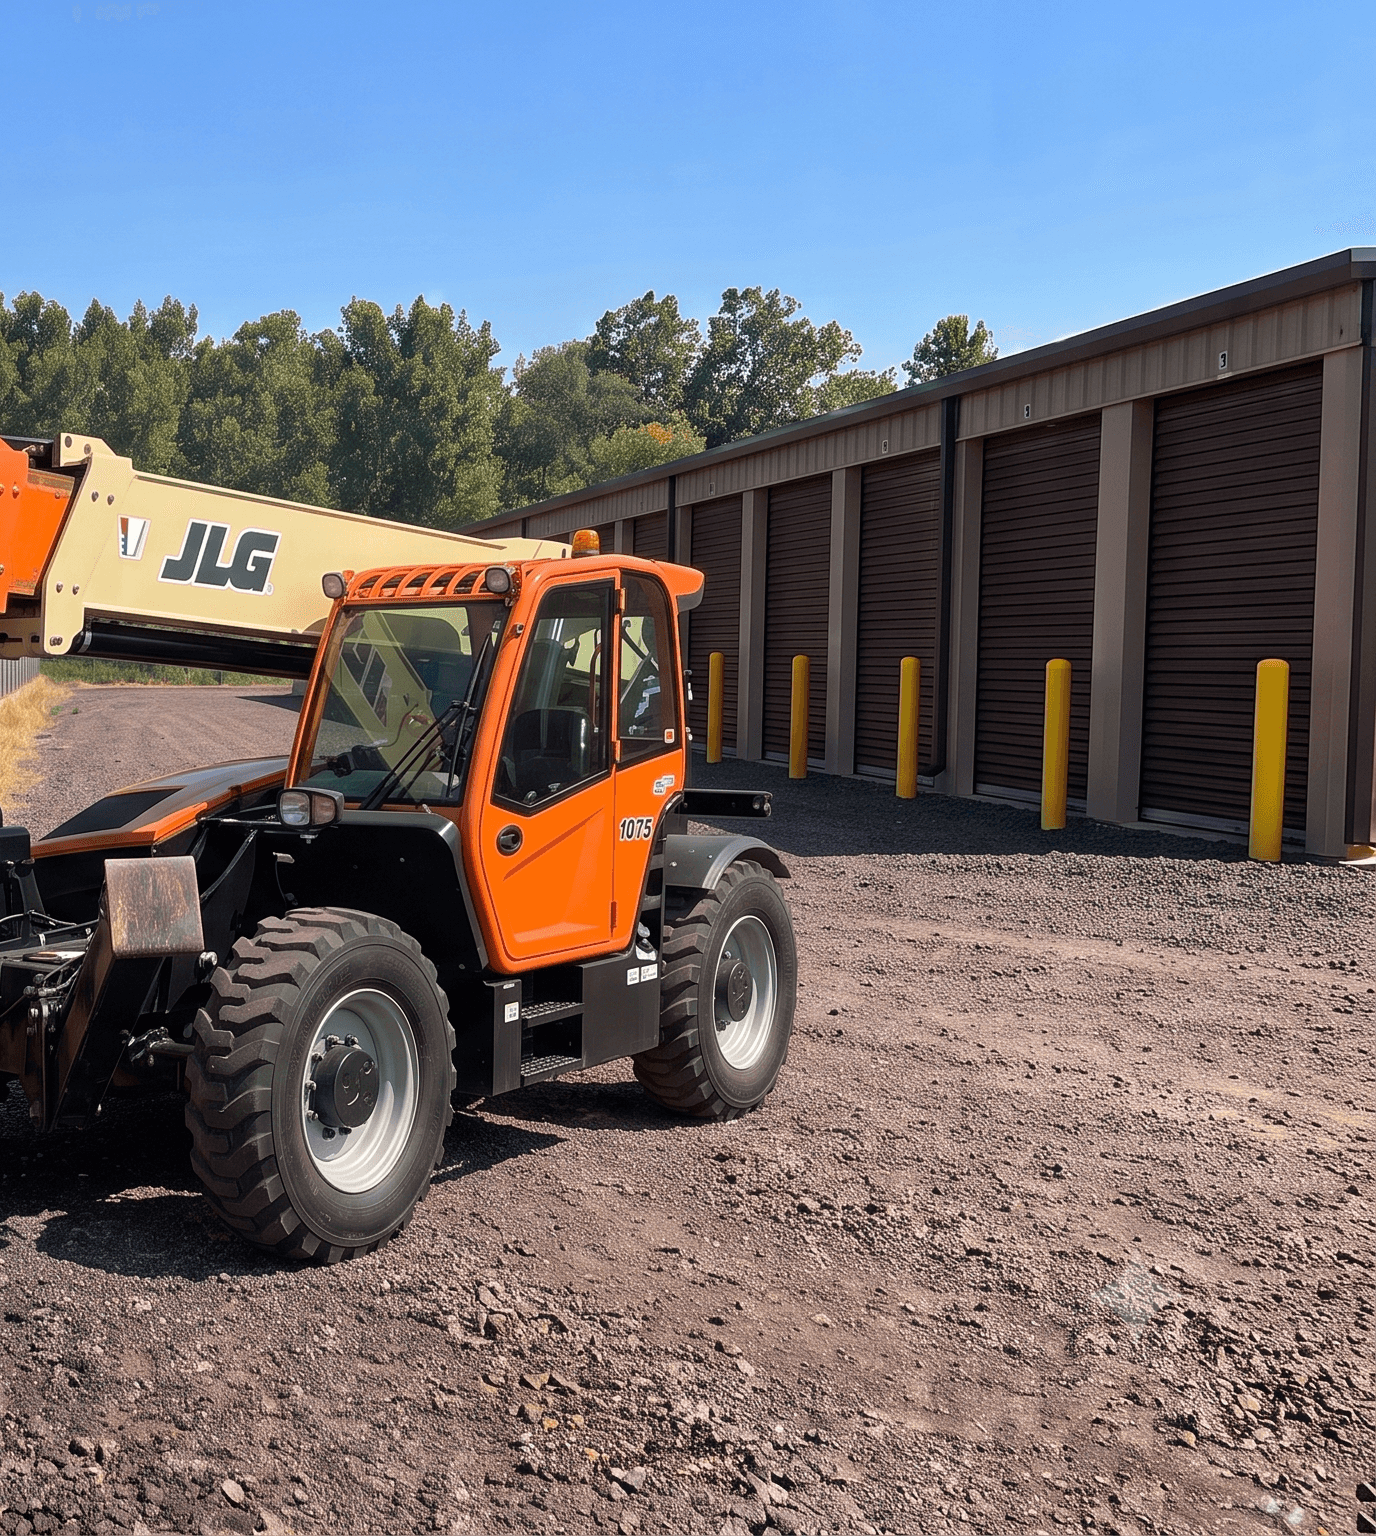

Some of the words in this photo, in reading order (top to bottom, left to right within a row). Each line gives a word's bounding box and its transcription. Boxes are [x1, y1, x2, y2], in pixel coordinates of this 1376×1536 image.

[1220, 352, 1227, 368] 3
[160, 521, 280, 593] JLG
[620, 818, 653, 840] 1075
